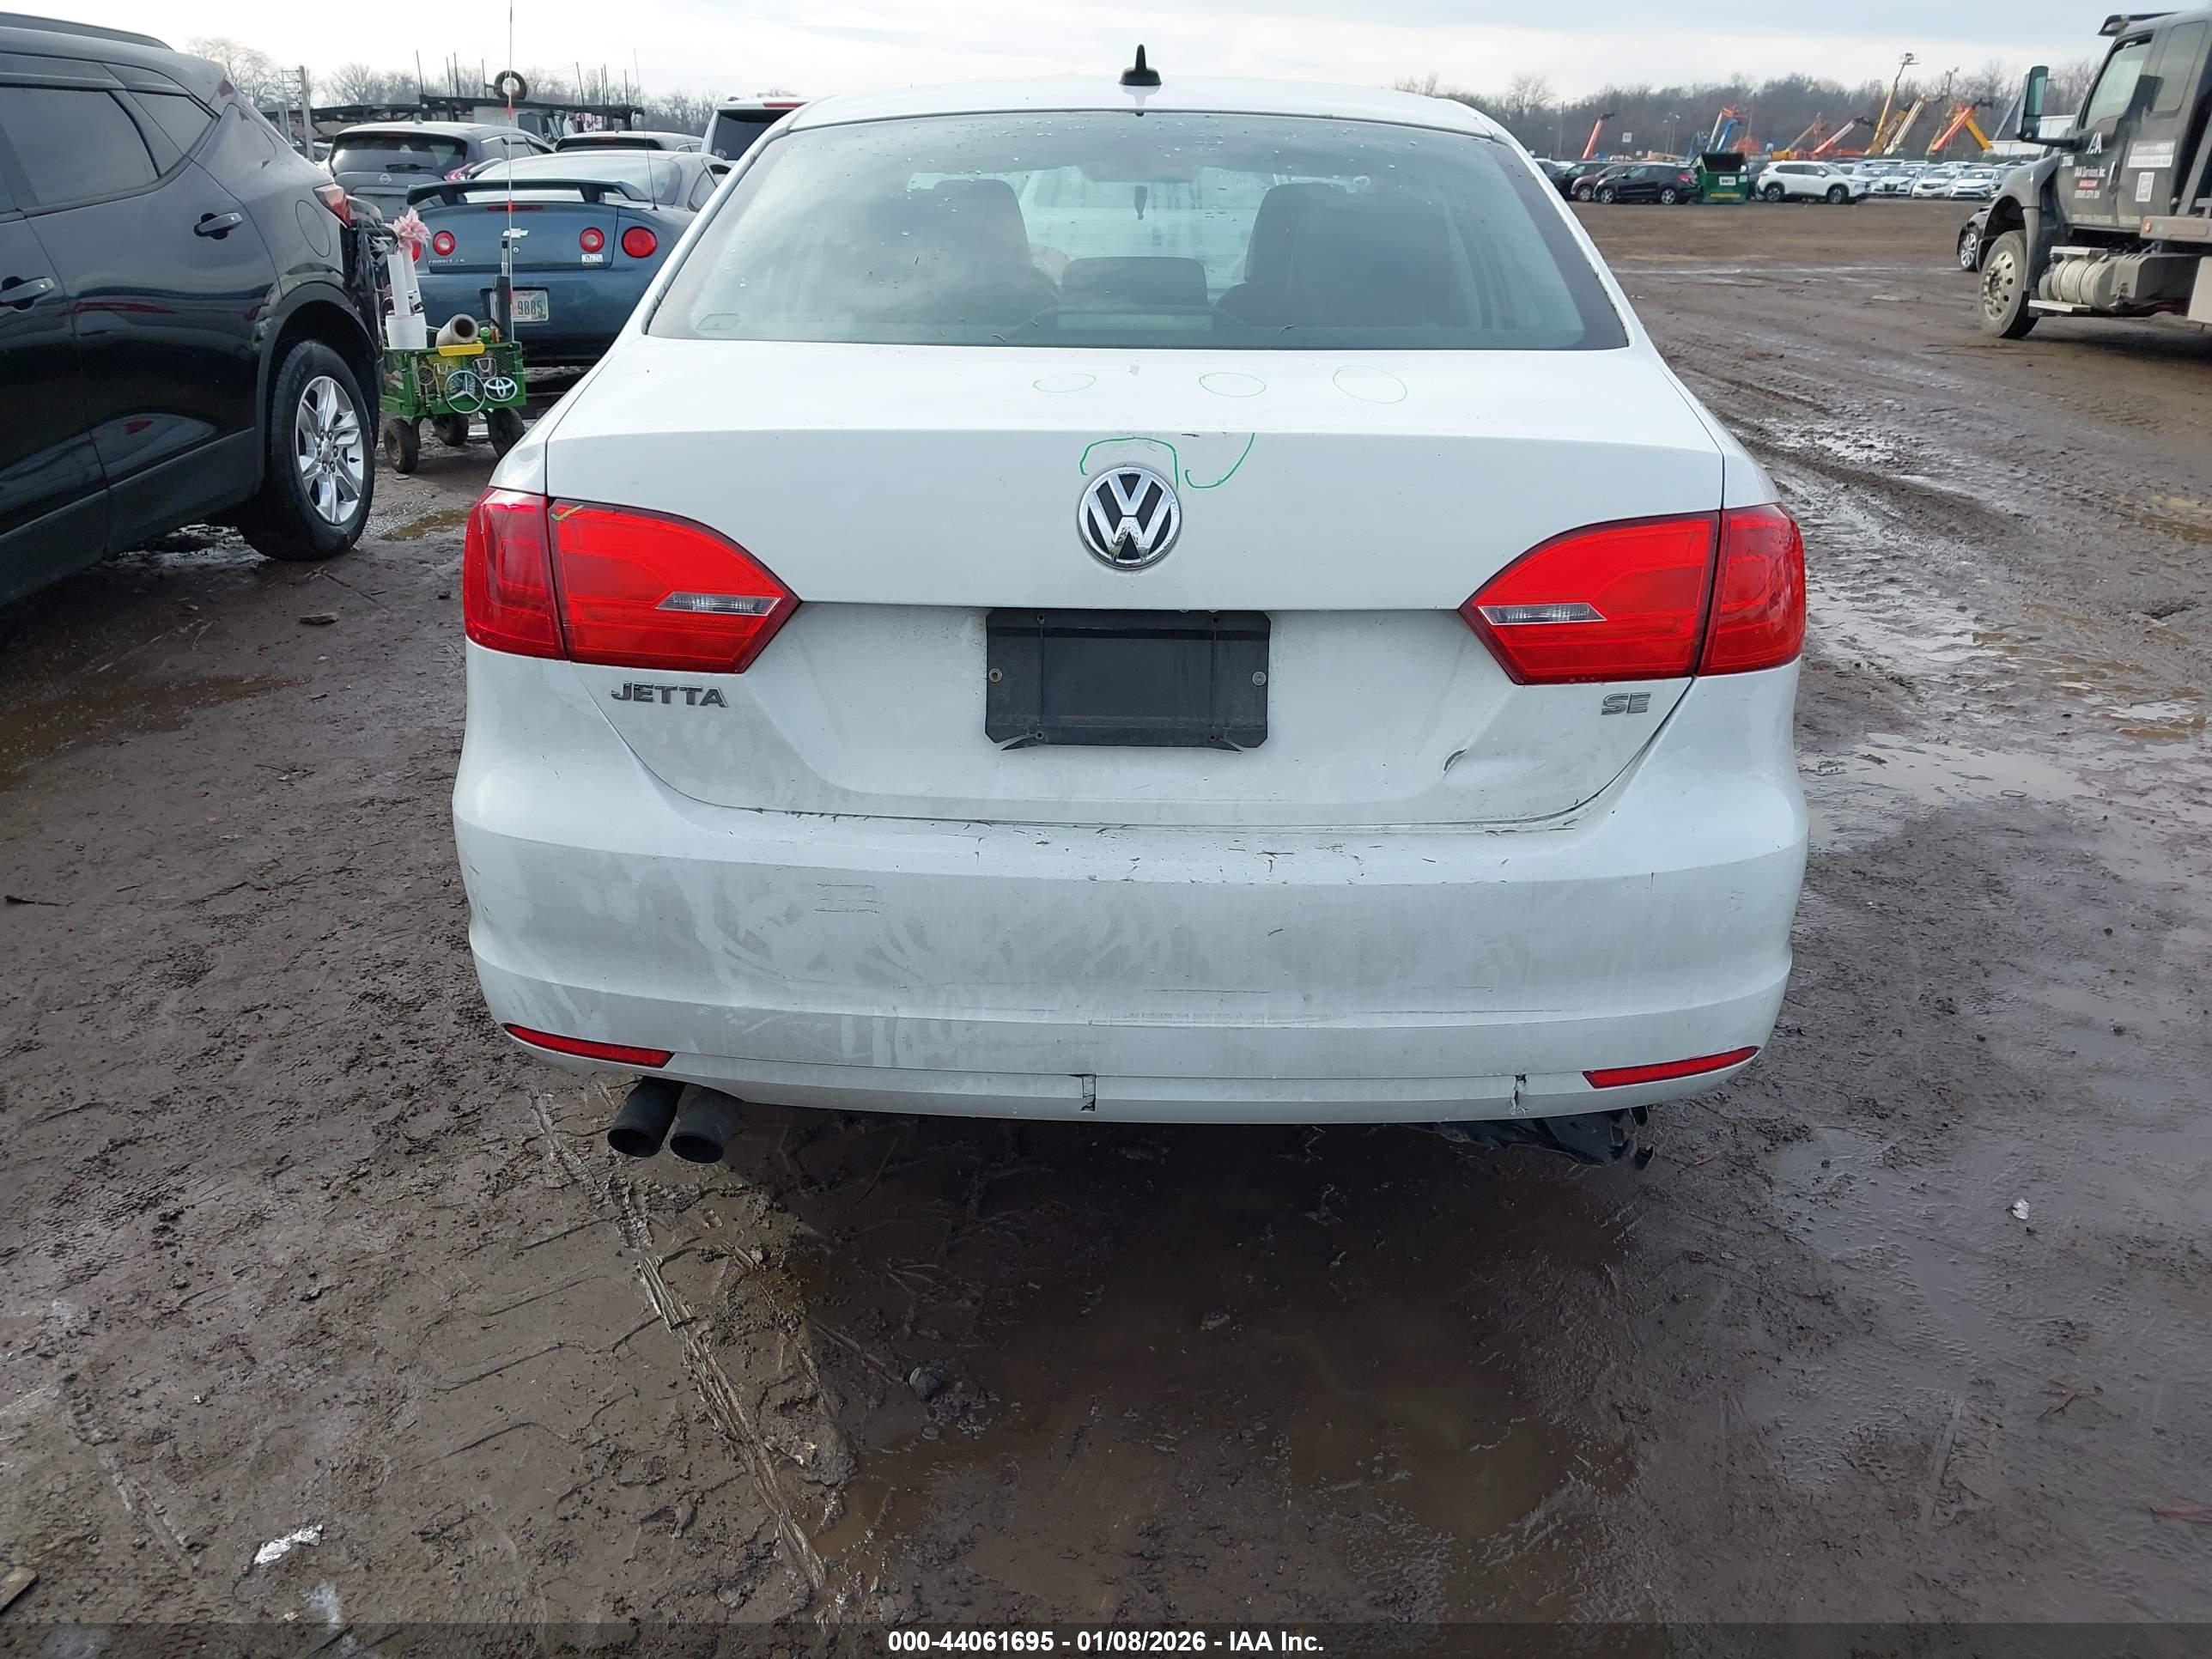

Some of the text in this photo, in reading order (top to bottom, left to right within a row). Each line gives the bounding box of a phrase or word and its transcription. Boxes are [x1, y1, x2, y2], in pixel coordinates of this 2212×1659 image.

[518, 301, 543, 315] 9885
[611, 681, 728, 708] JETTA
[1601, 691, 1652, 716] SE
